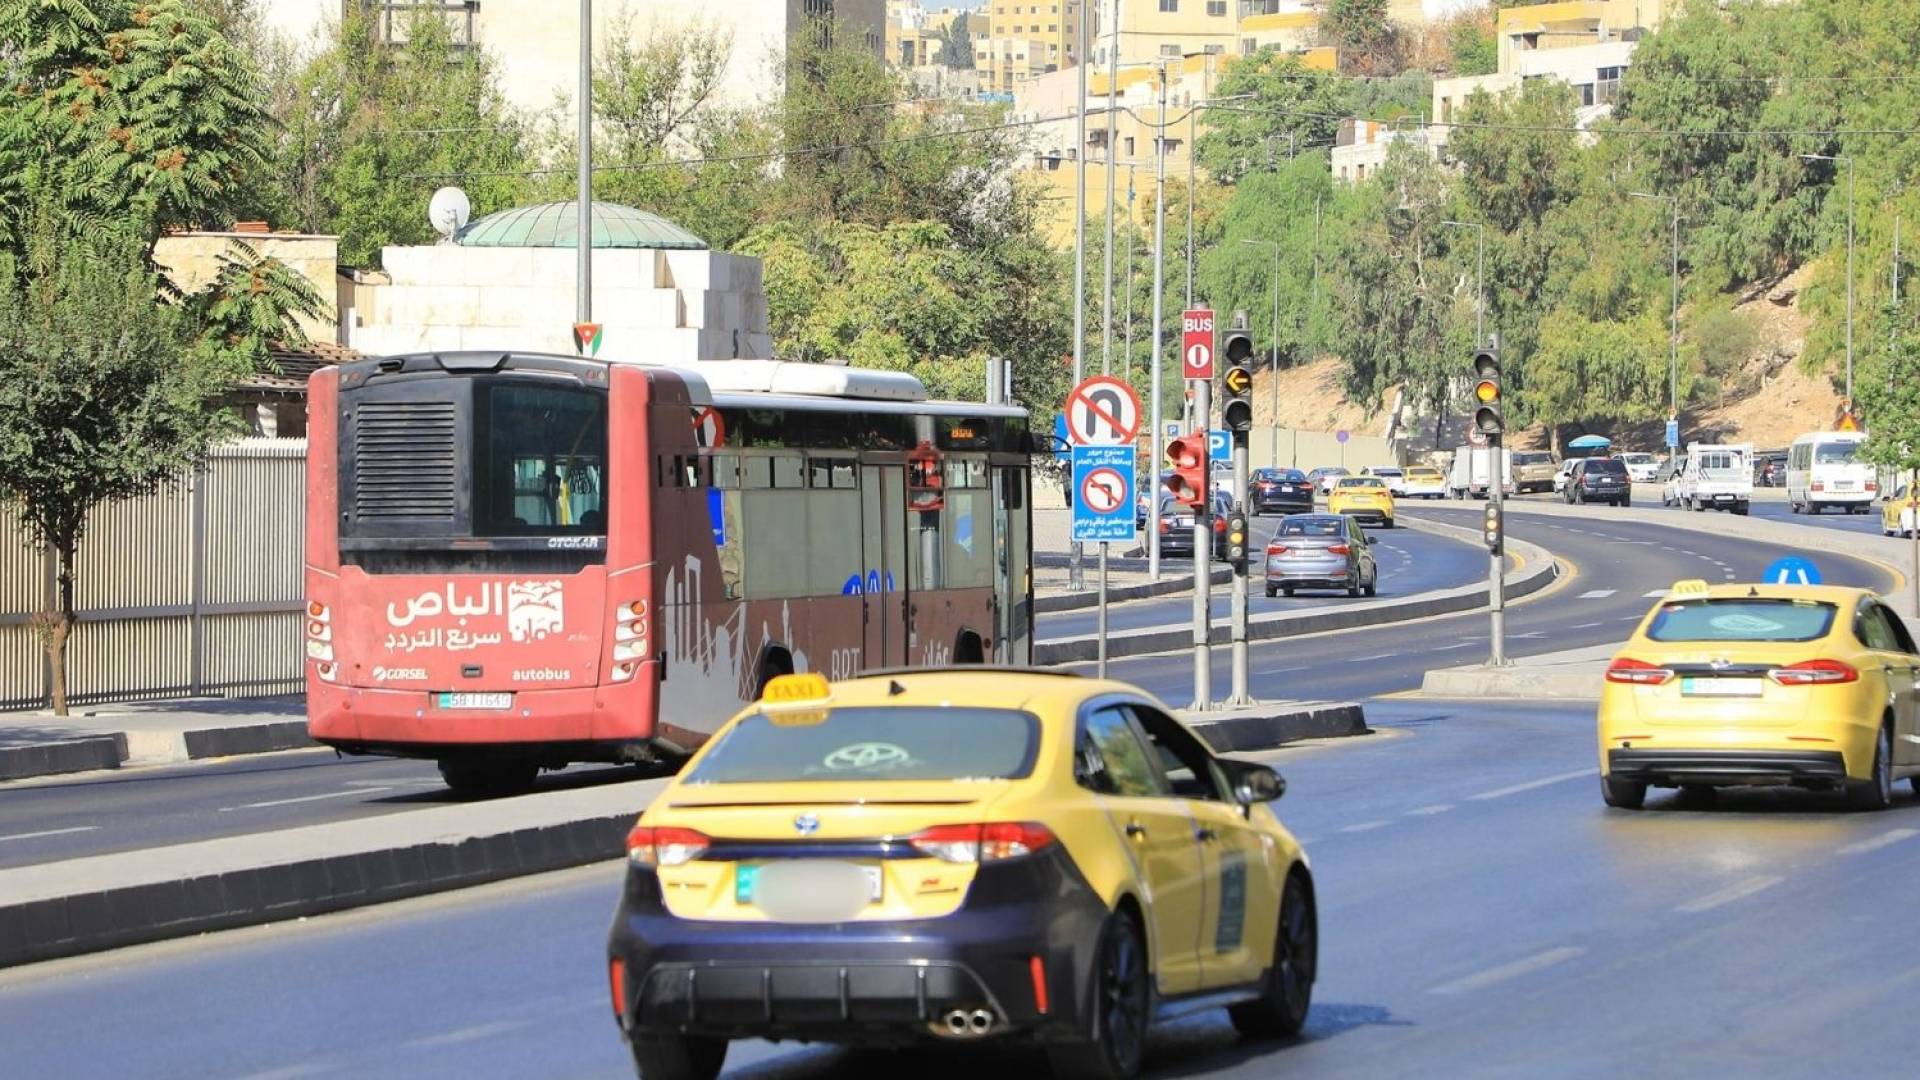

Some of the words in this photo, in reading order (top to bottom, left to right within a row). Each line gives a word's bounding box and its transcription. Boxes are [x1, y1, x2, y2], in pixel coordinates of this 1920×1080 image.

[1184, 318, 1213, 333] BUS
[1209, 435, 1225, 456] P
[547, 536, 599, 548] OTOKAR
[1677, 583, 1703, 593] TAXI
[386, 582, 503, 627] الباص
[384, 628, 442, 653] التردد
[446, 628, 502, 651] سريع
[512, 667, 571, 681] autobus
[772, 682, 815, 699] TAXI
